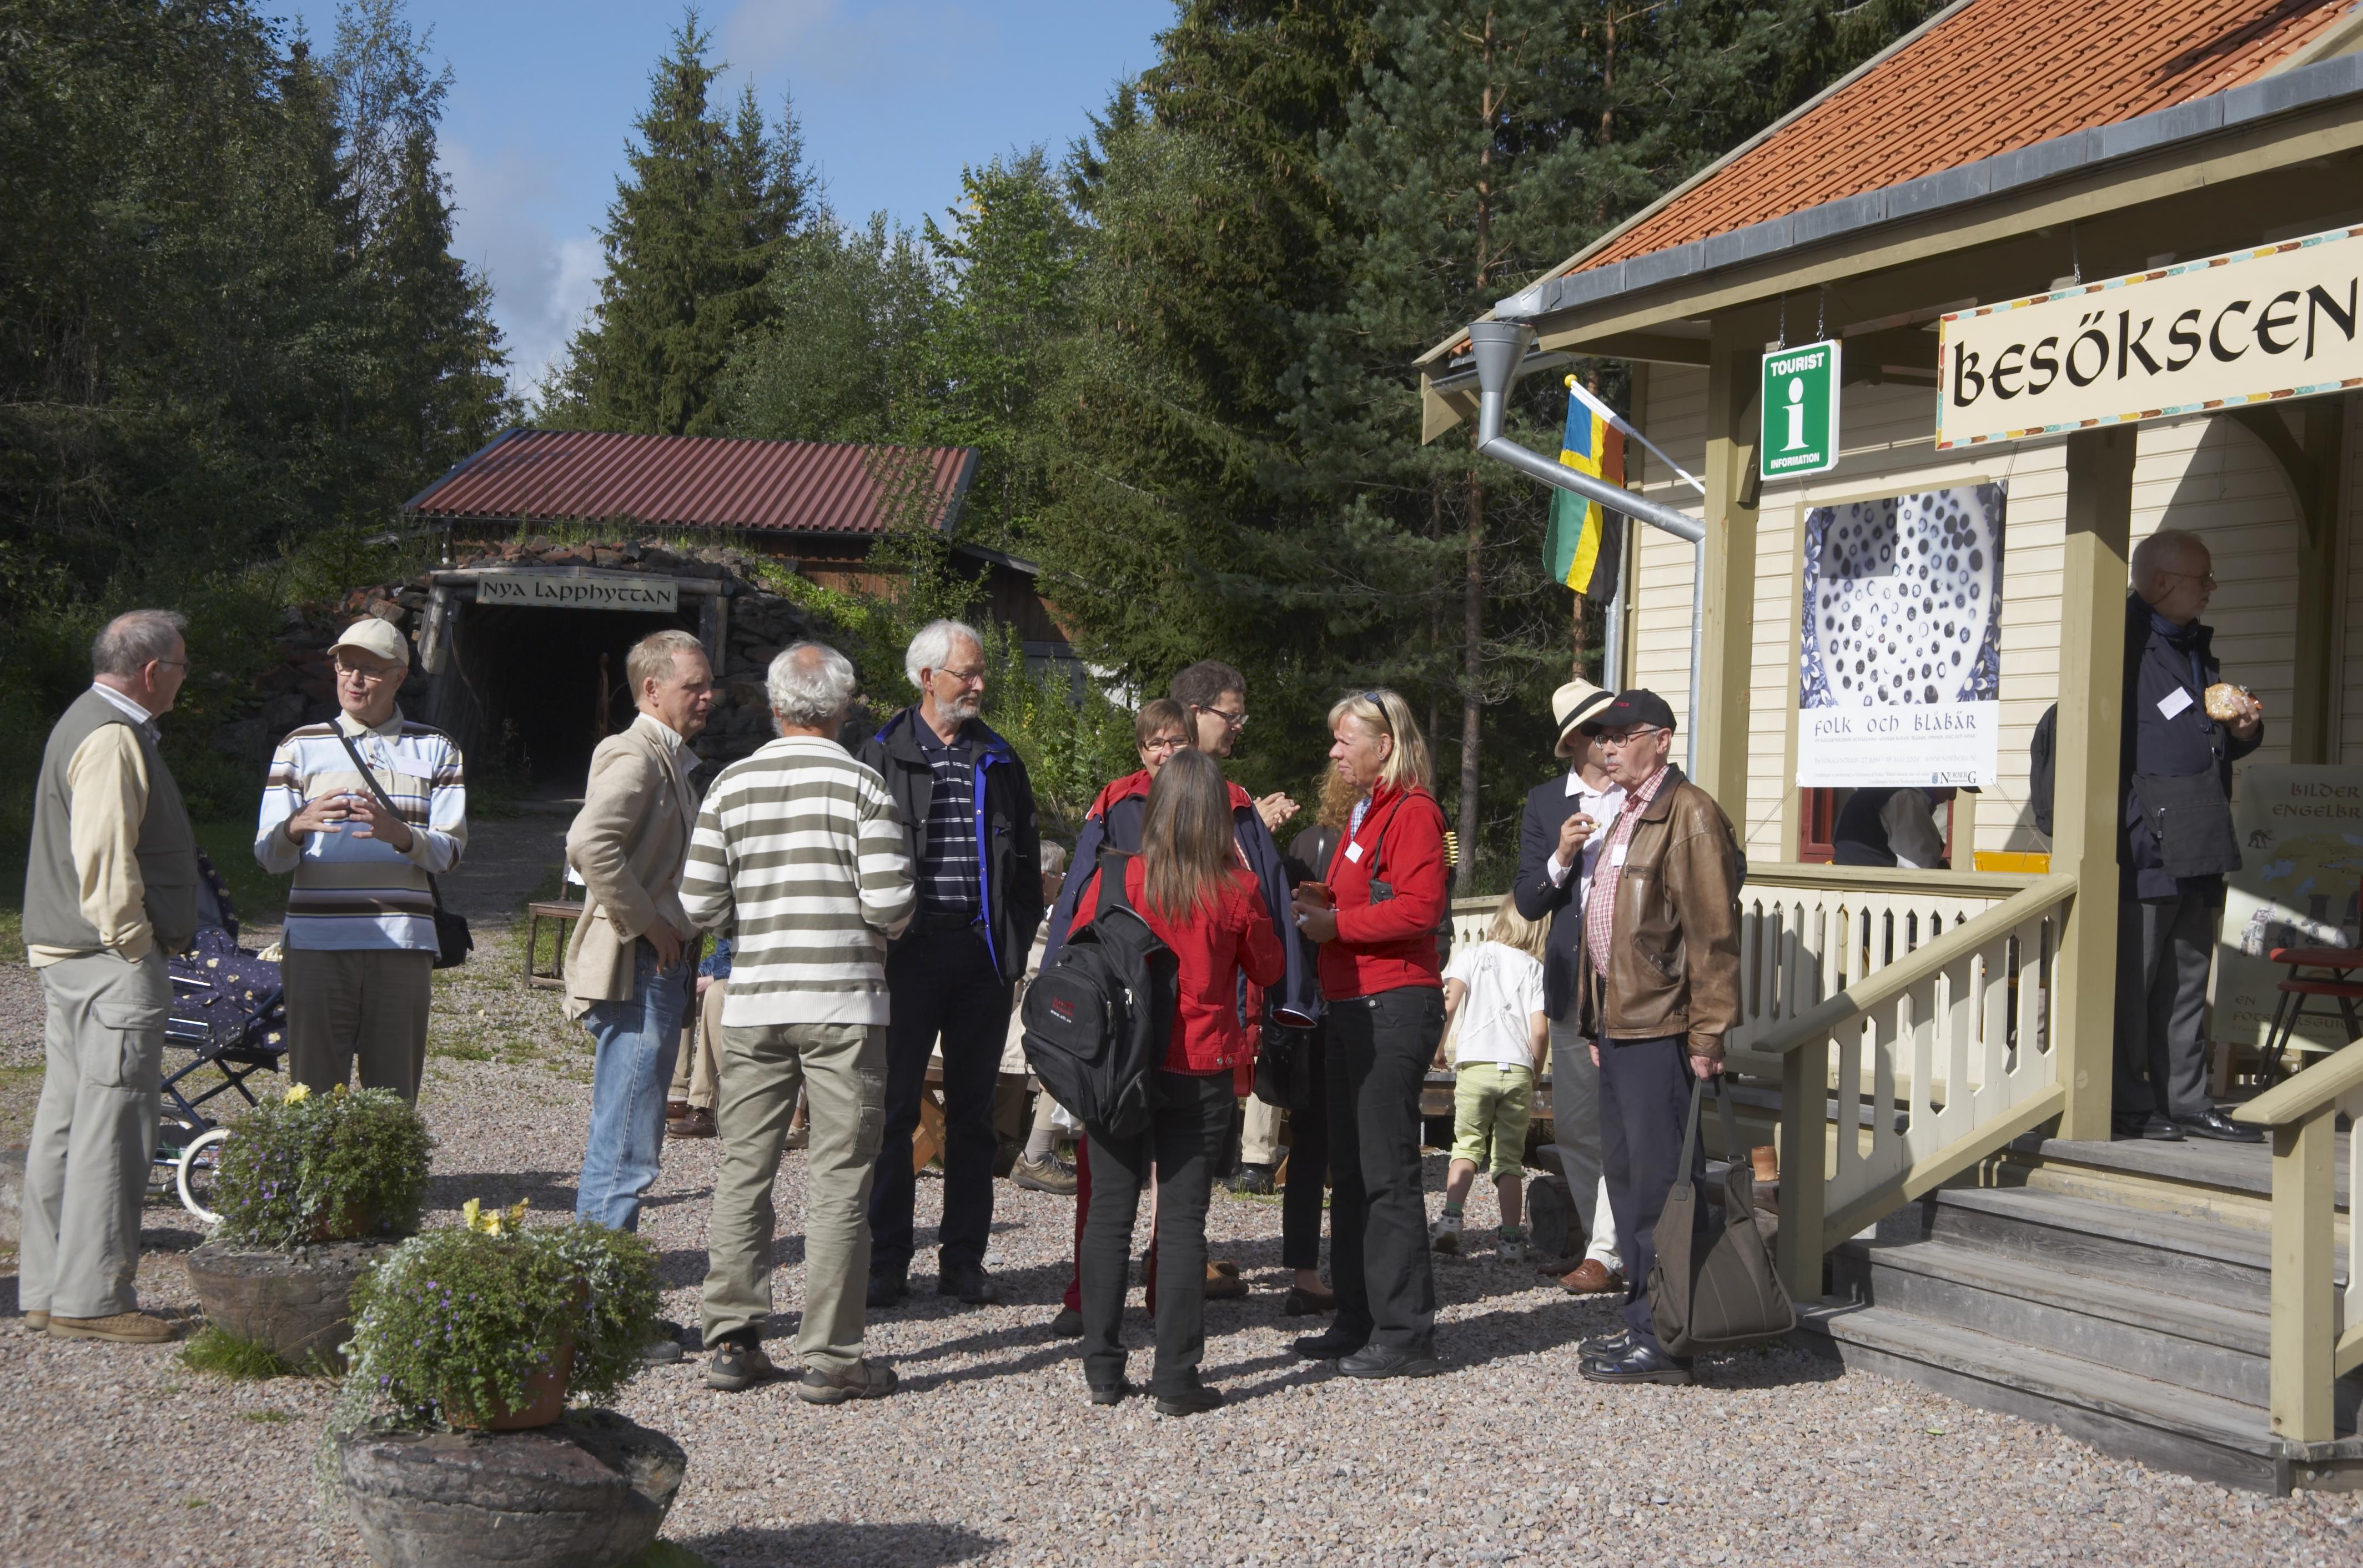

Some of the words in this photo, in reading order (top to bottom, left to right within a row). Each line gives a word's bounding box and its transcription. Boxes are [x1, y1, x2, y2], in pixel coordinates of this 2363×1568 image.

[1953, 276, 2358, 408] BESÖKSCEN
[1771, 352, 1824, 377] TOURIST
[1771, 452, 1819, 469] INFORMATION
[1815, 717, 1852, 736] FOLK
[1914, 711, 1977, 731] BLÅBÄR
[2291, 782, 2360, 798] BILDER
[2272, 803, 2361, 818] ENGELBR
[2235, 996, 2256, 1007] EN
